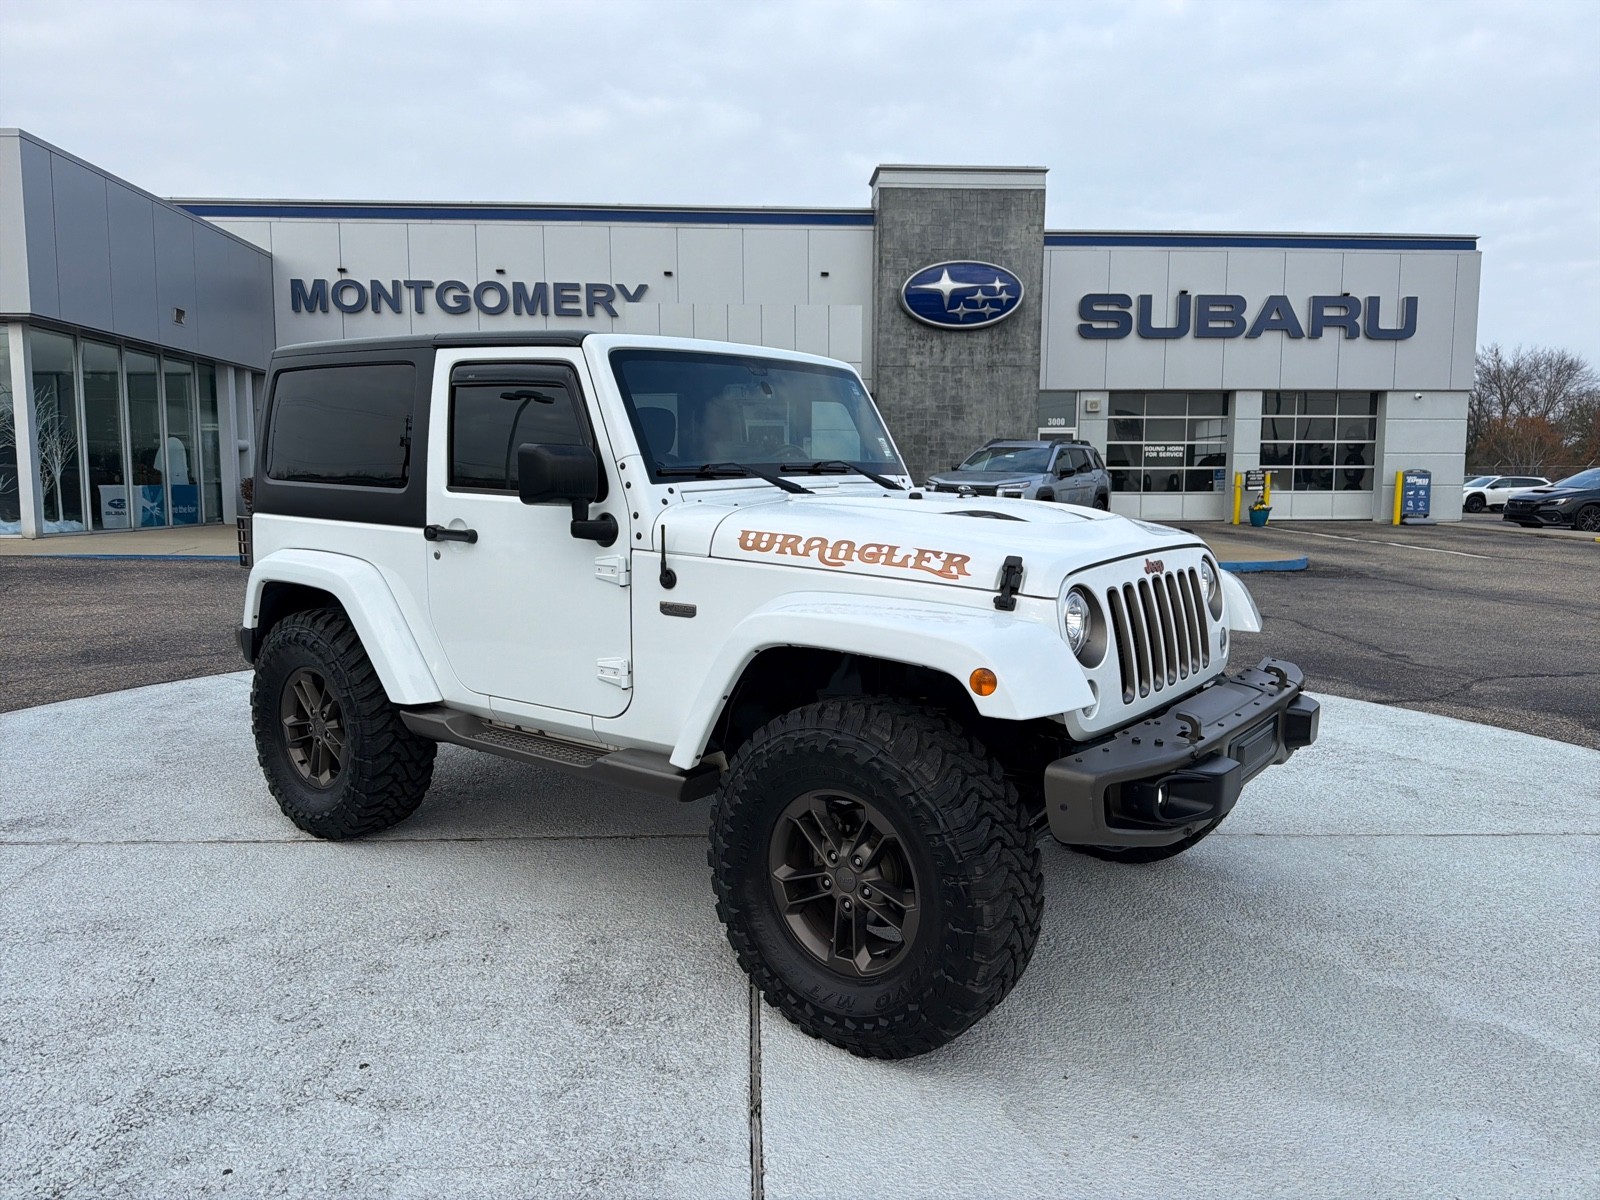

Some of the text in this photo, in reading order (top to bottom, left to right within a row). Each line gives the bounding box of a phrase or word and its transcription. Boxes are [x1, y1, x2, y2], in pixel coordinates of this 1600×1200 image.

[289, 278, 649, 317] MONTGOMERY
[1077, 293, 1419, 340] SUBARU
[1047, 417, 1065, 426] 3000
[737, 530, 971, 579] WRANGLER
[1144, 558, 1164, 575] Jeep
